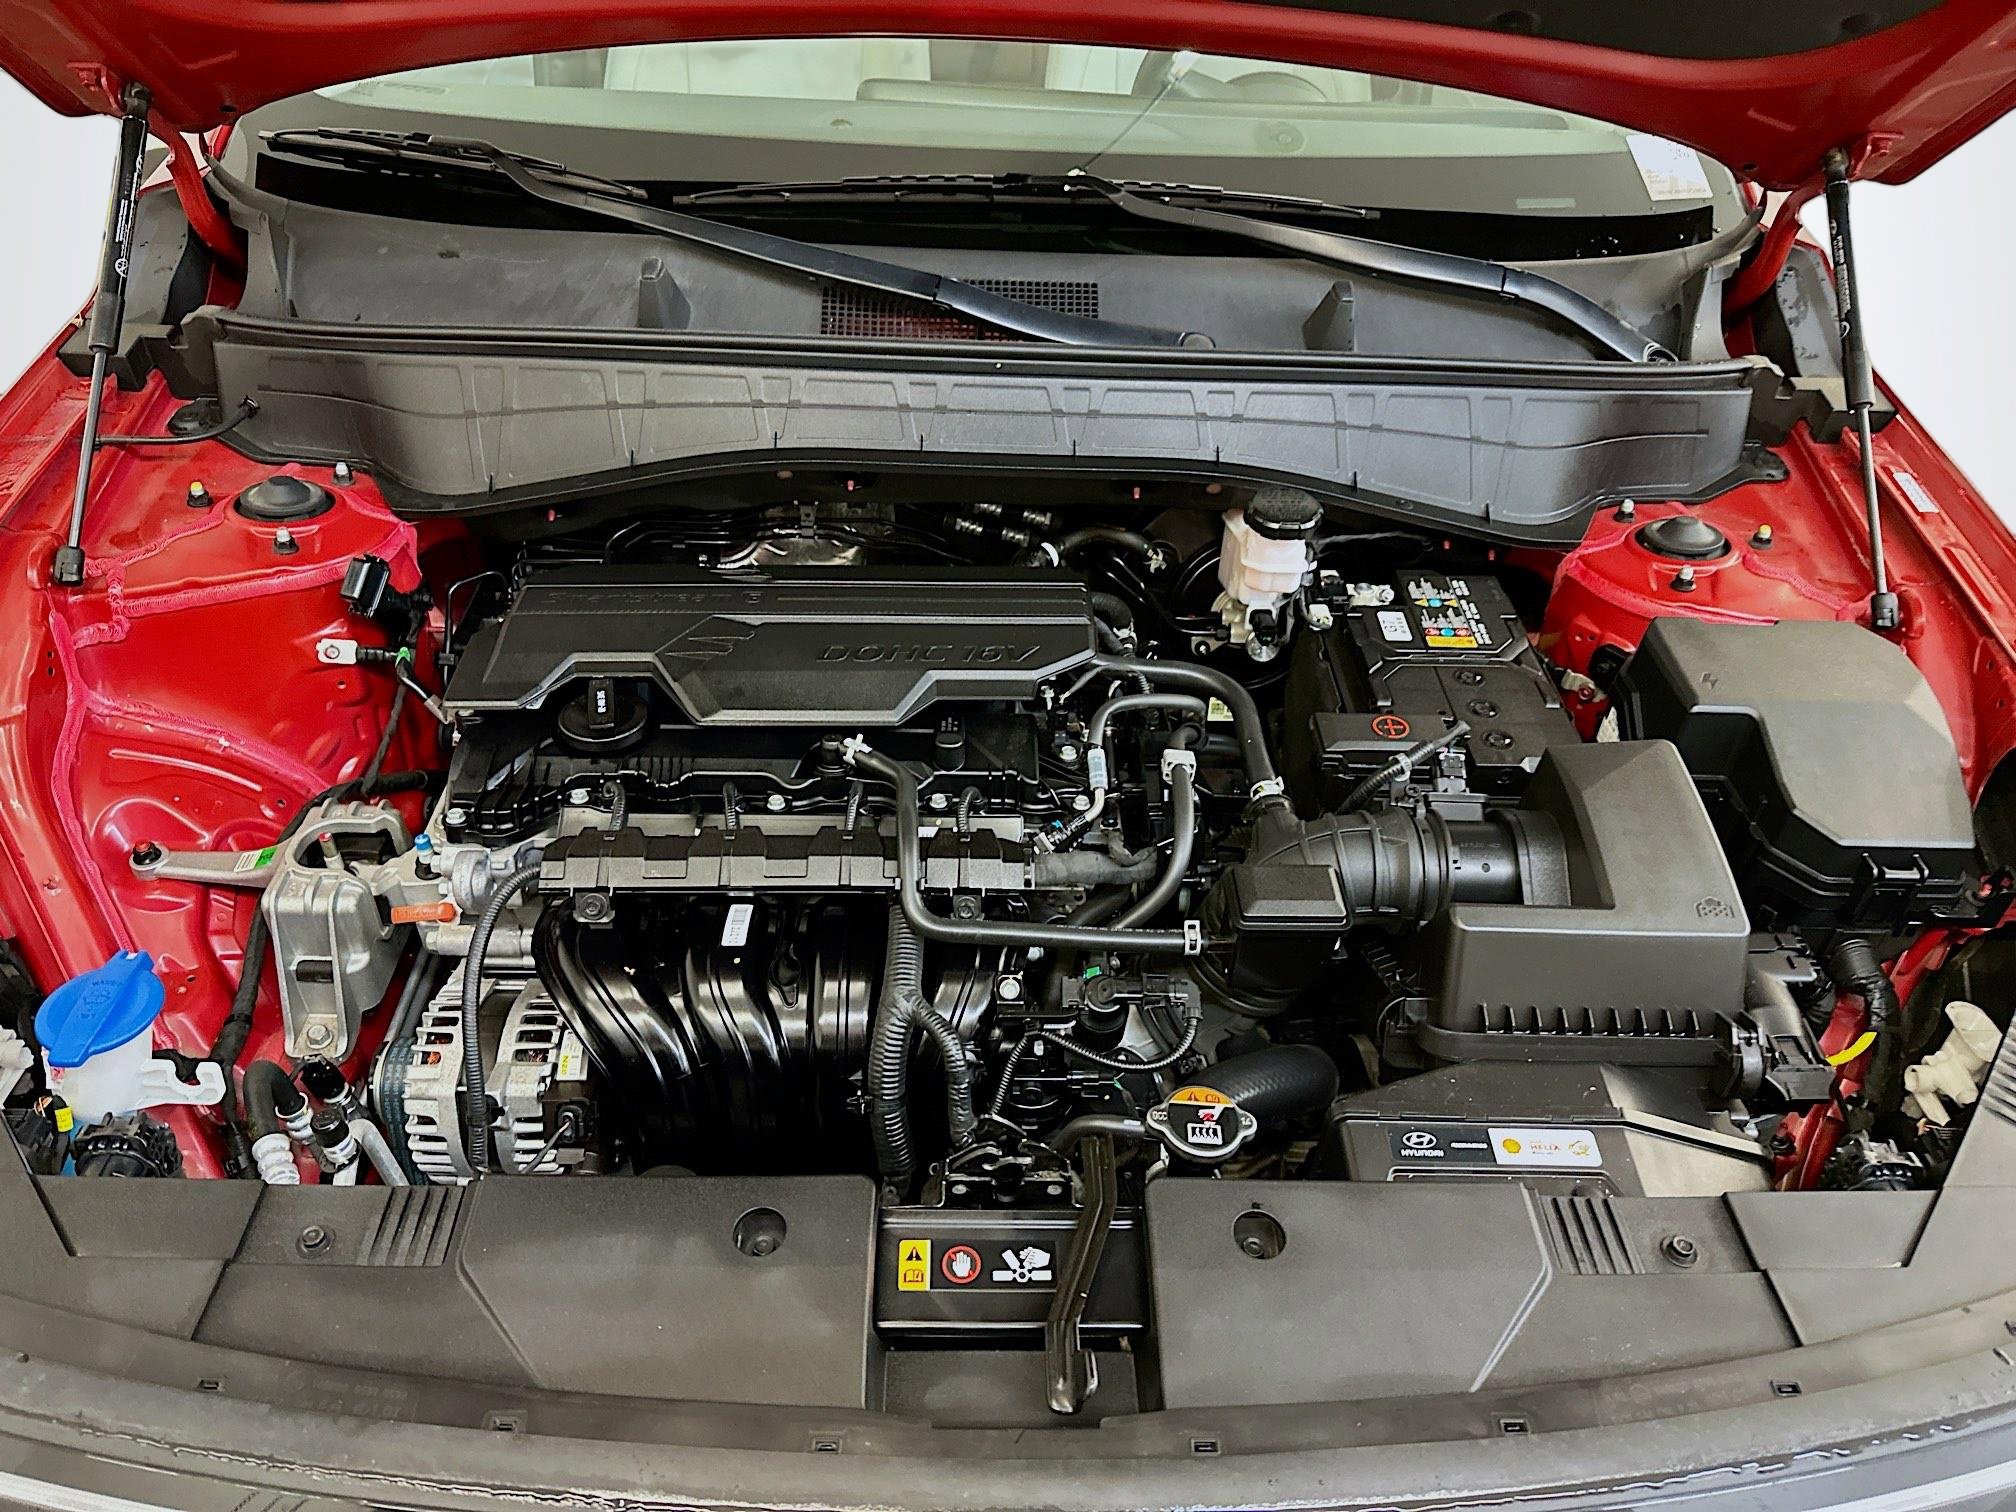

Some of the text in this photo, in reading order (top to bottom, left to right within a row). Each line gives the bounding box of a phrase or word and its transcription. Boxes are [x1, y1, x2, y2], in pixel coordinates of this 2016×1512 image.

[816, 644, 1041, 663] DOHC 16V
[1400, 1148, 1445, 1158] HYUNDAI
